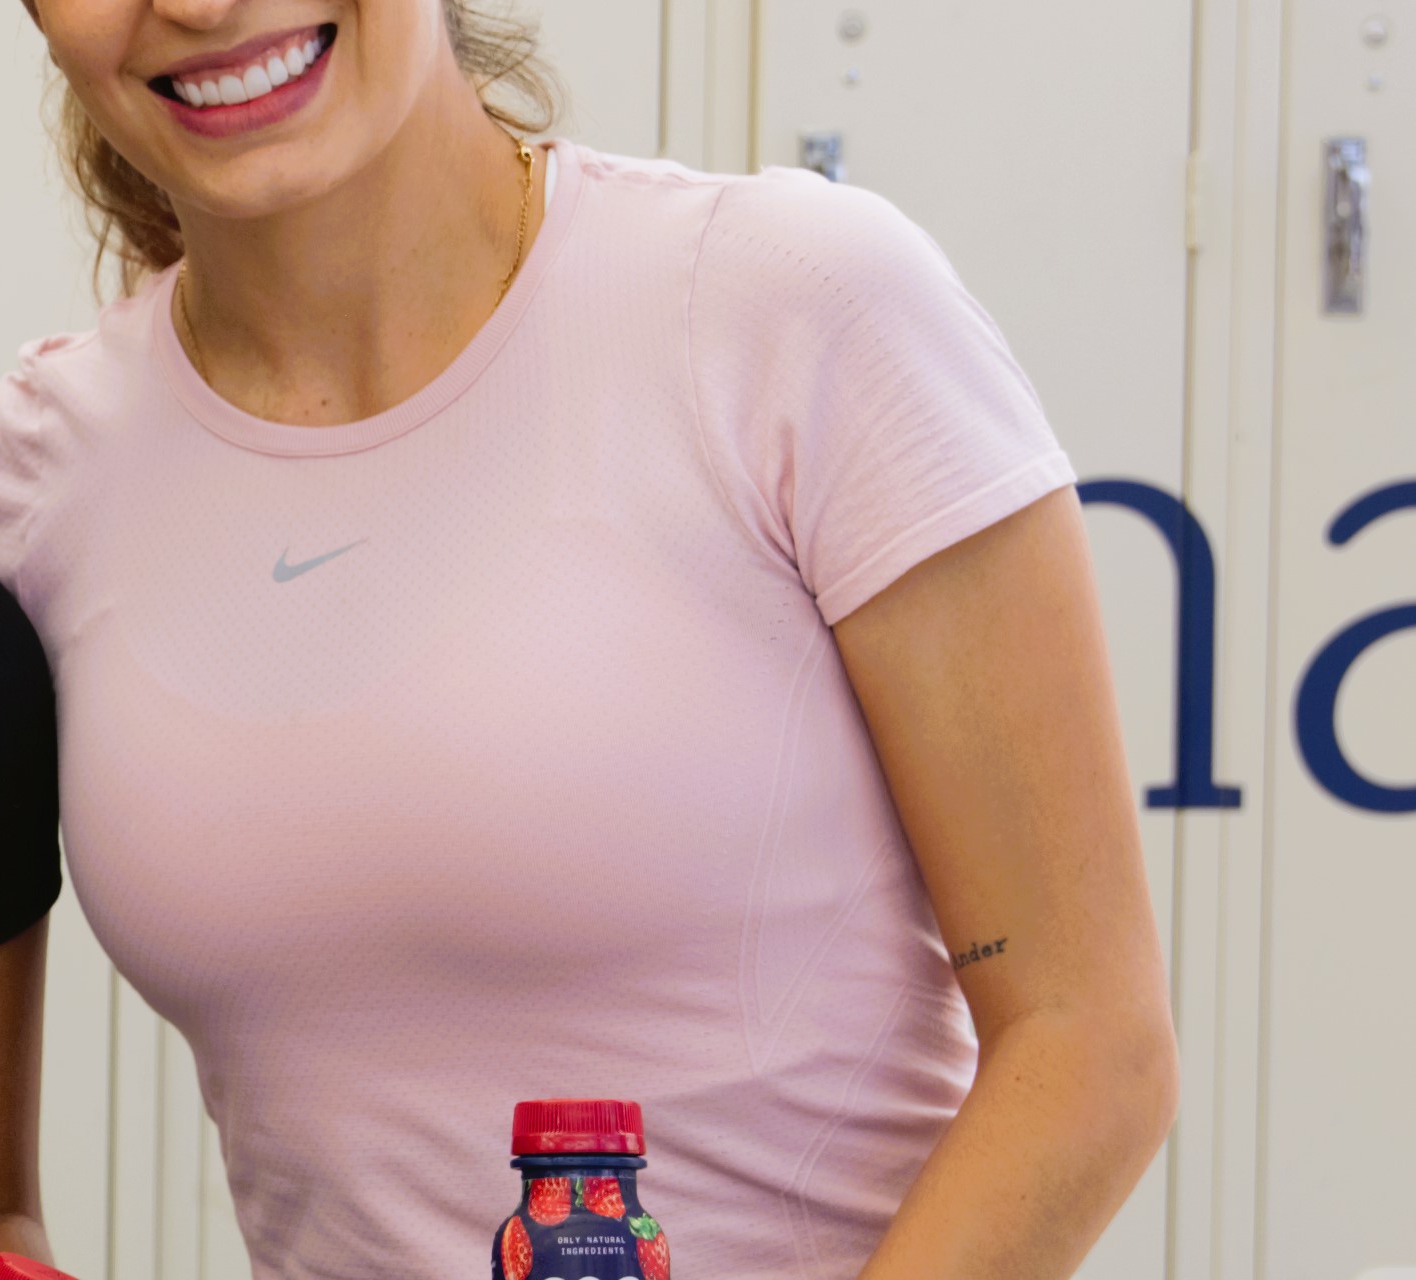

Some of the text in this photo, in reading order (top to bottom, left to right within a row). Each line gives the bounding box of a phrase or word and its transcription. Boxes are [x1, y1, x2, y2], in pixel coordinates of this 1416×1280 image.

[557, 1236, 626, 1244] ONLY NATURAL
[561, 1247, 625, 1256] INGREDIENTS
